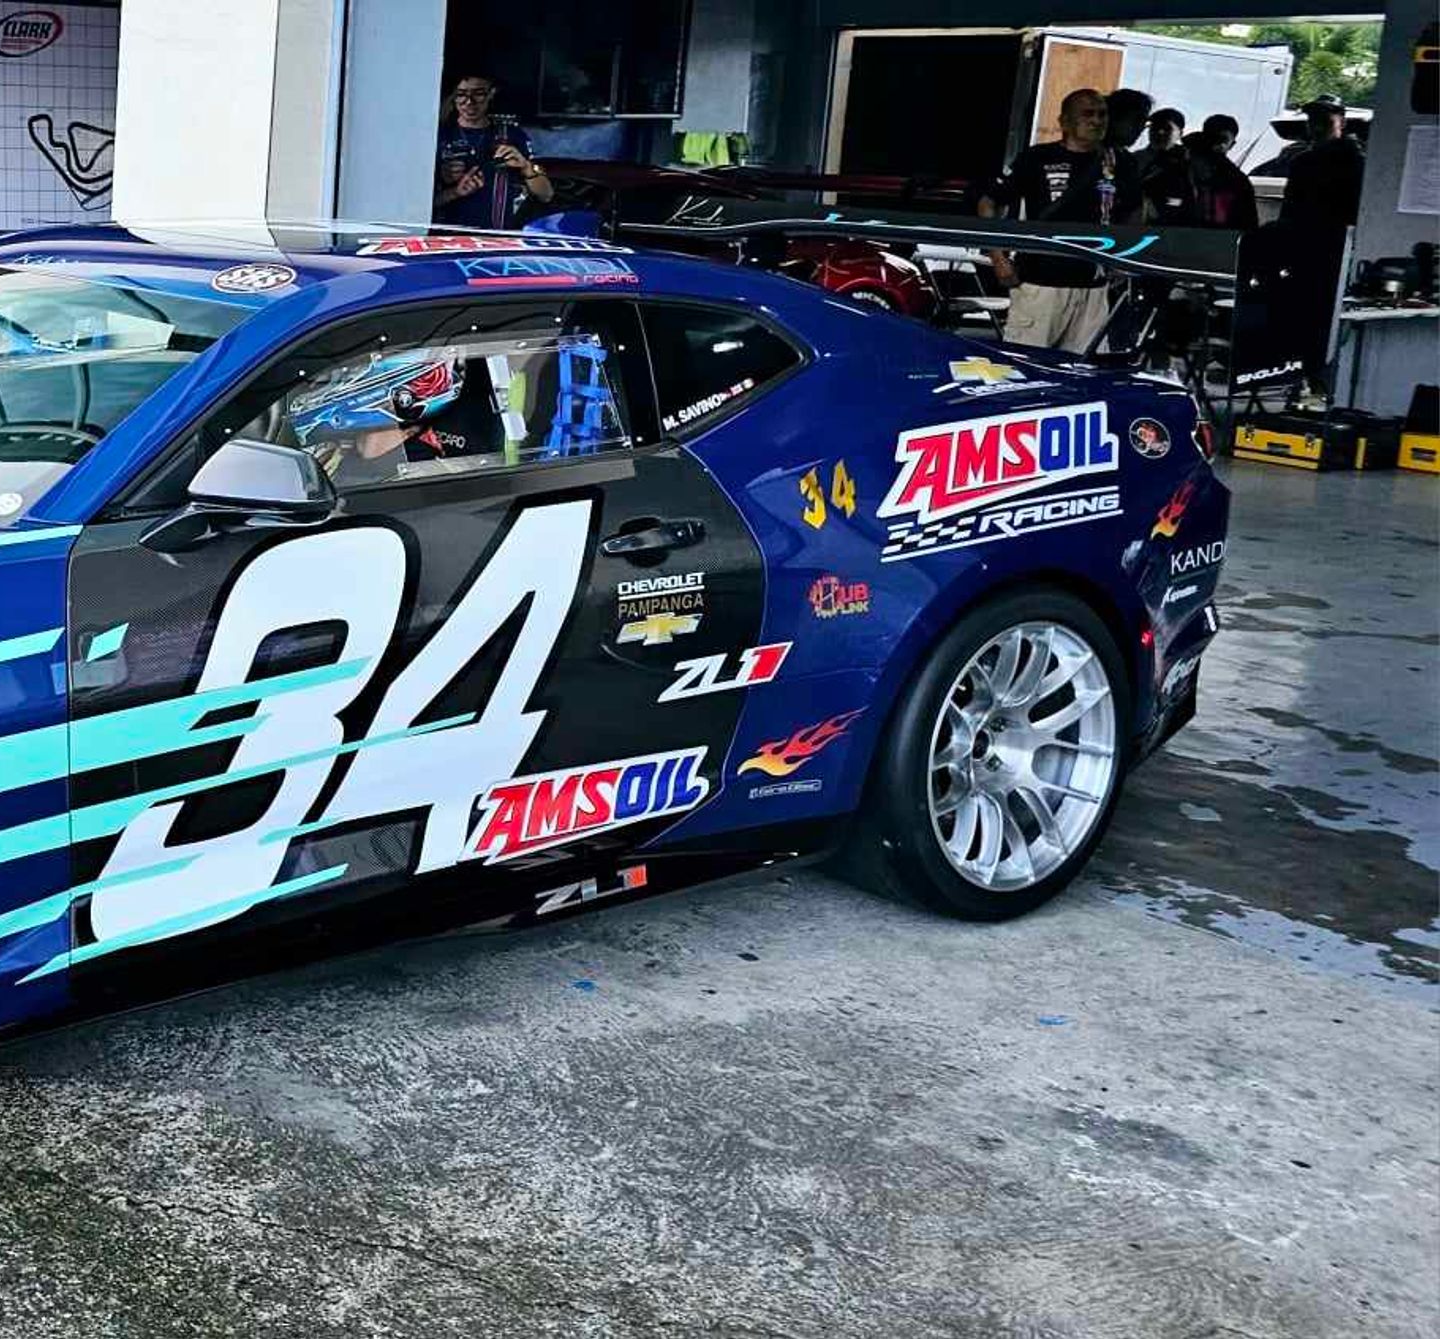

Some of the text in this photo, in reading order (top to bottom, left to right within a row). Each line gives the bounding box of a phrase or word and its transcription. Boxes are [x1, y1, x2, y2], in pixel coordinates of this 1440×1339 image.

[454, 256, 632, 278] KANDI
[662, 393, 723, 431] M. SAVINO
[895, 410, 1114, 513] AMSOIL
[978, 492, 1120, 537] RACING
[617, 572, 705, 595] CHEVROLET
[617, 593, 704, 619] PAMPANGA
[657, 641, 794, 703] ZL1
[475, 755, 703, 857] AMSOIL
